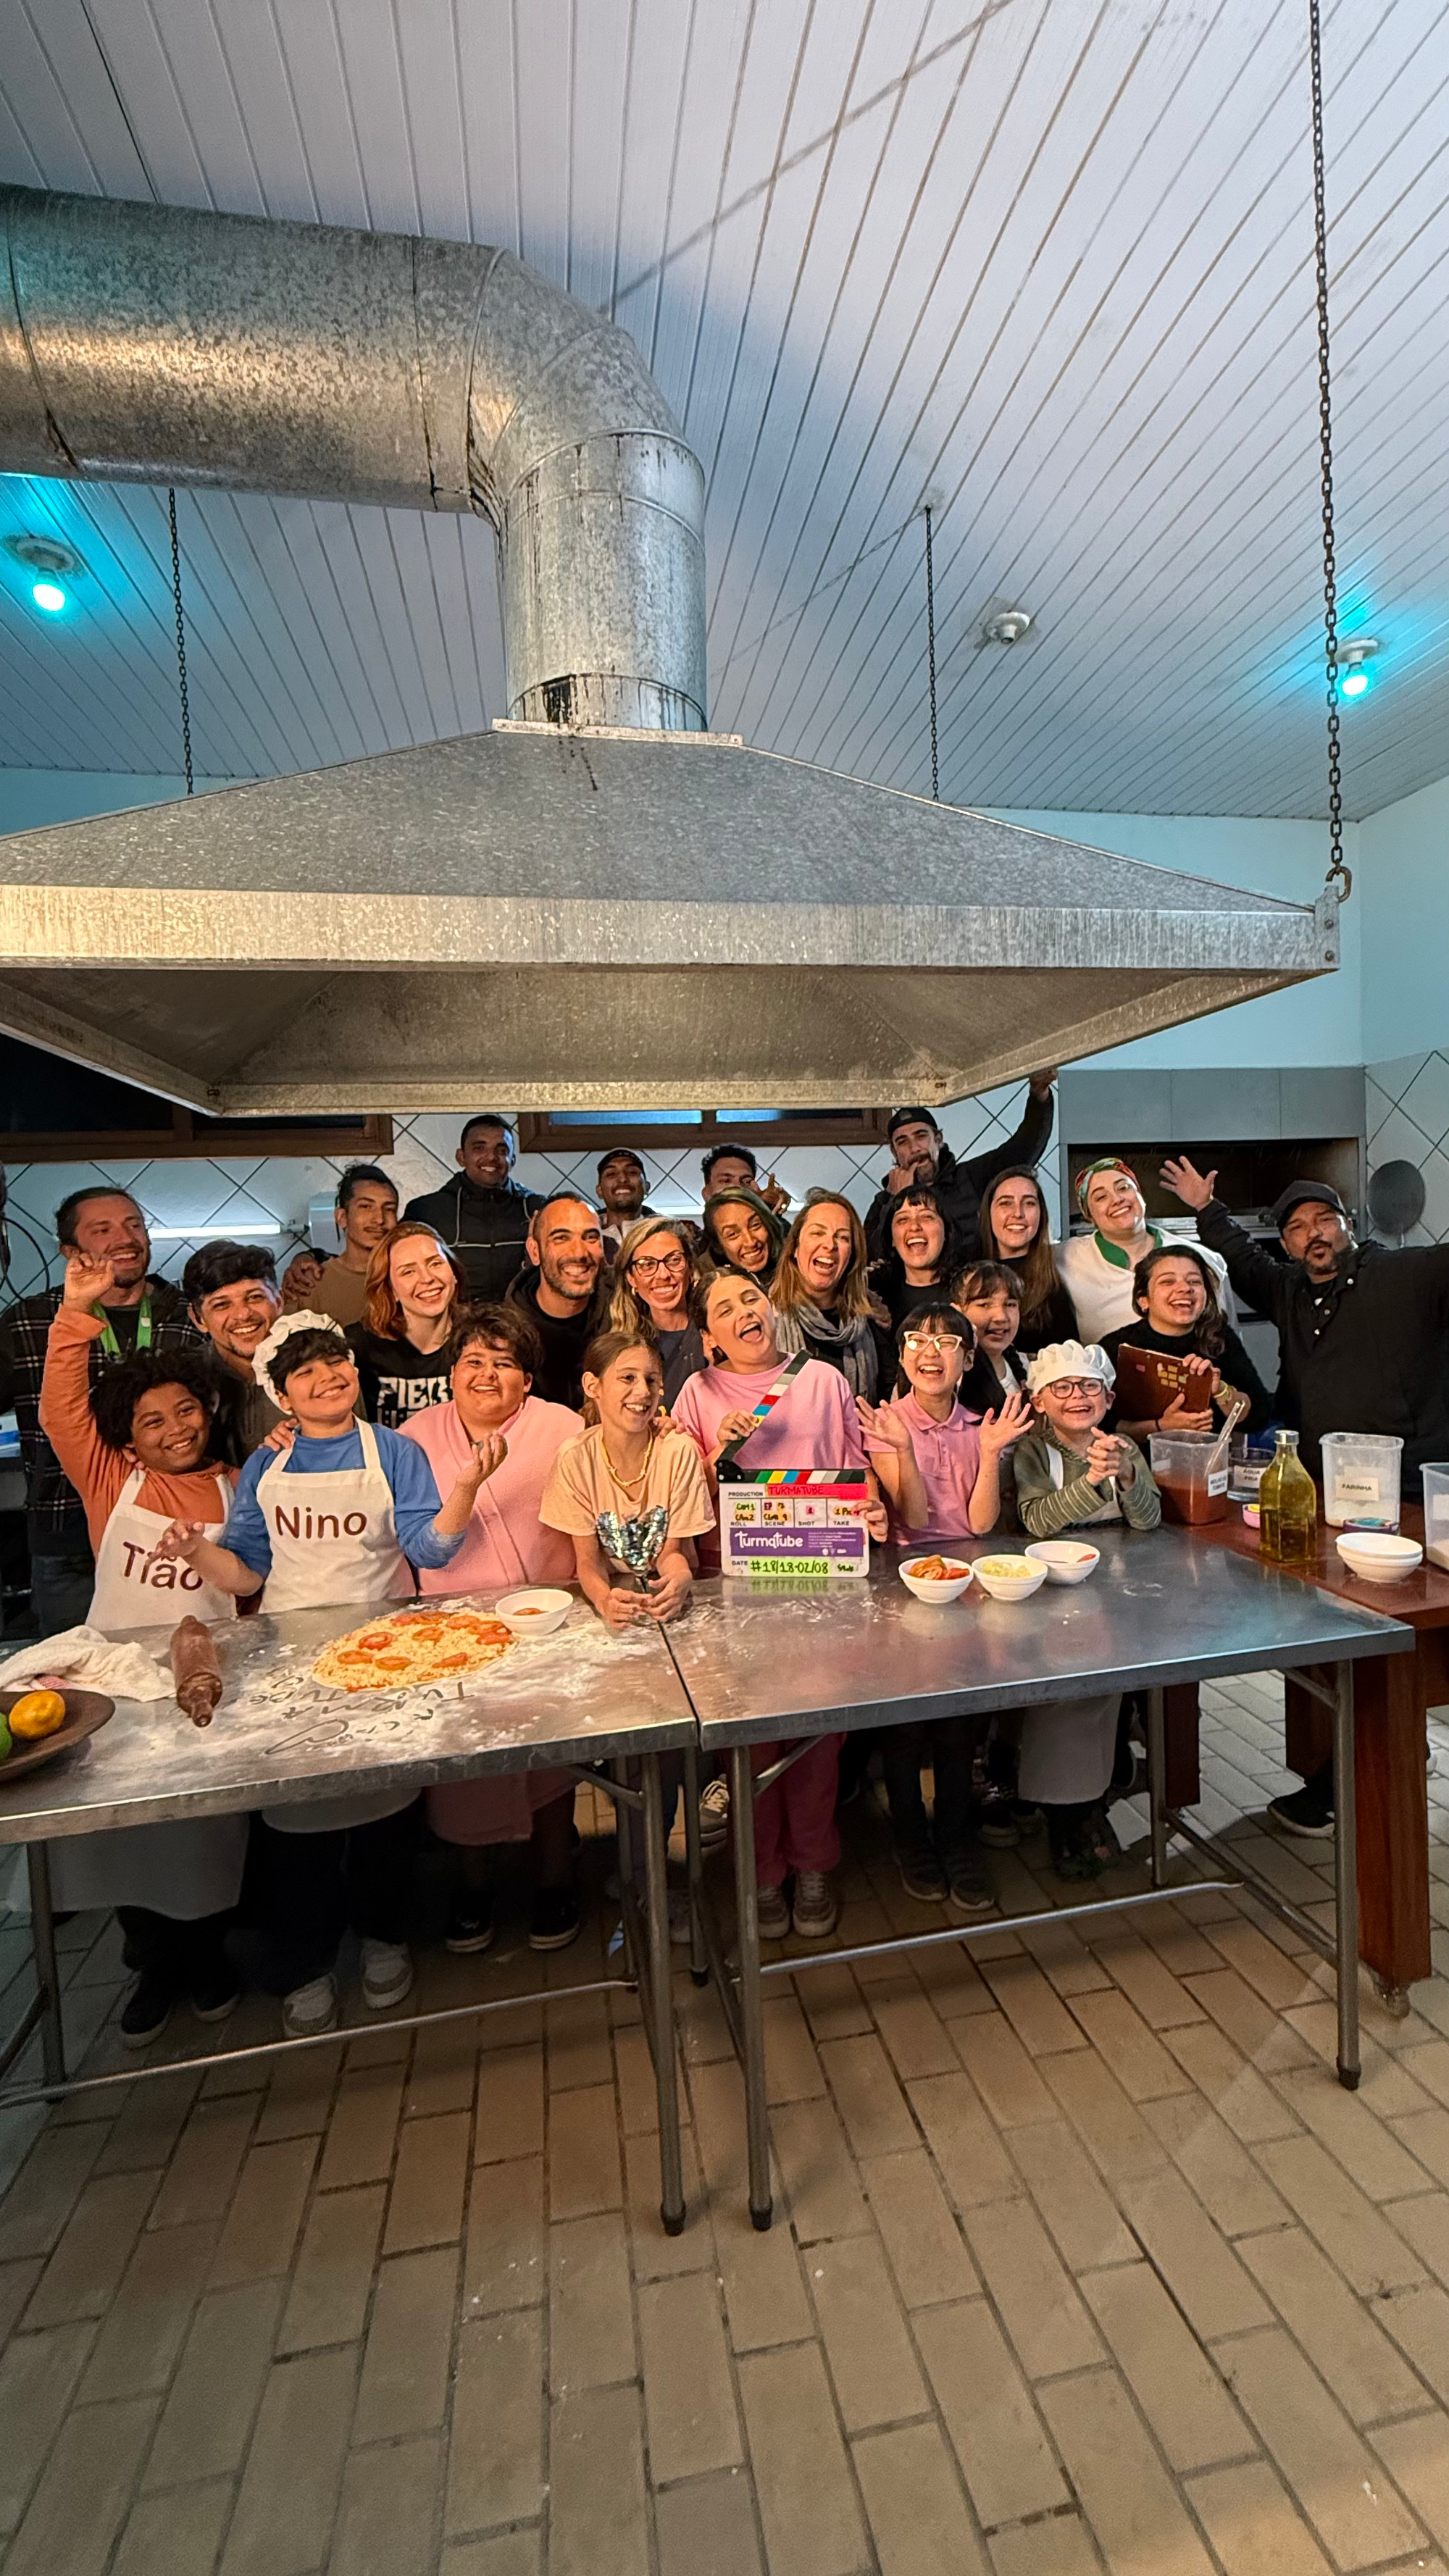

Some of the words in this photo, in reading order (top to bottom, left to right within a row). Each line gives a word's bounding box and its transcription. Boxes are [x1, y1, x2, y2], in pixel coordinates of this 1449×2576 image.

[769, 1486, 824, 1495] TURMATUBE
[1342, 1483, 1372, 1492] FARINHA
[275, 1505, 367, 1539] Nino
